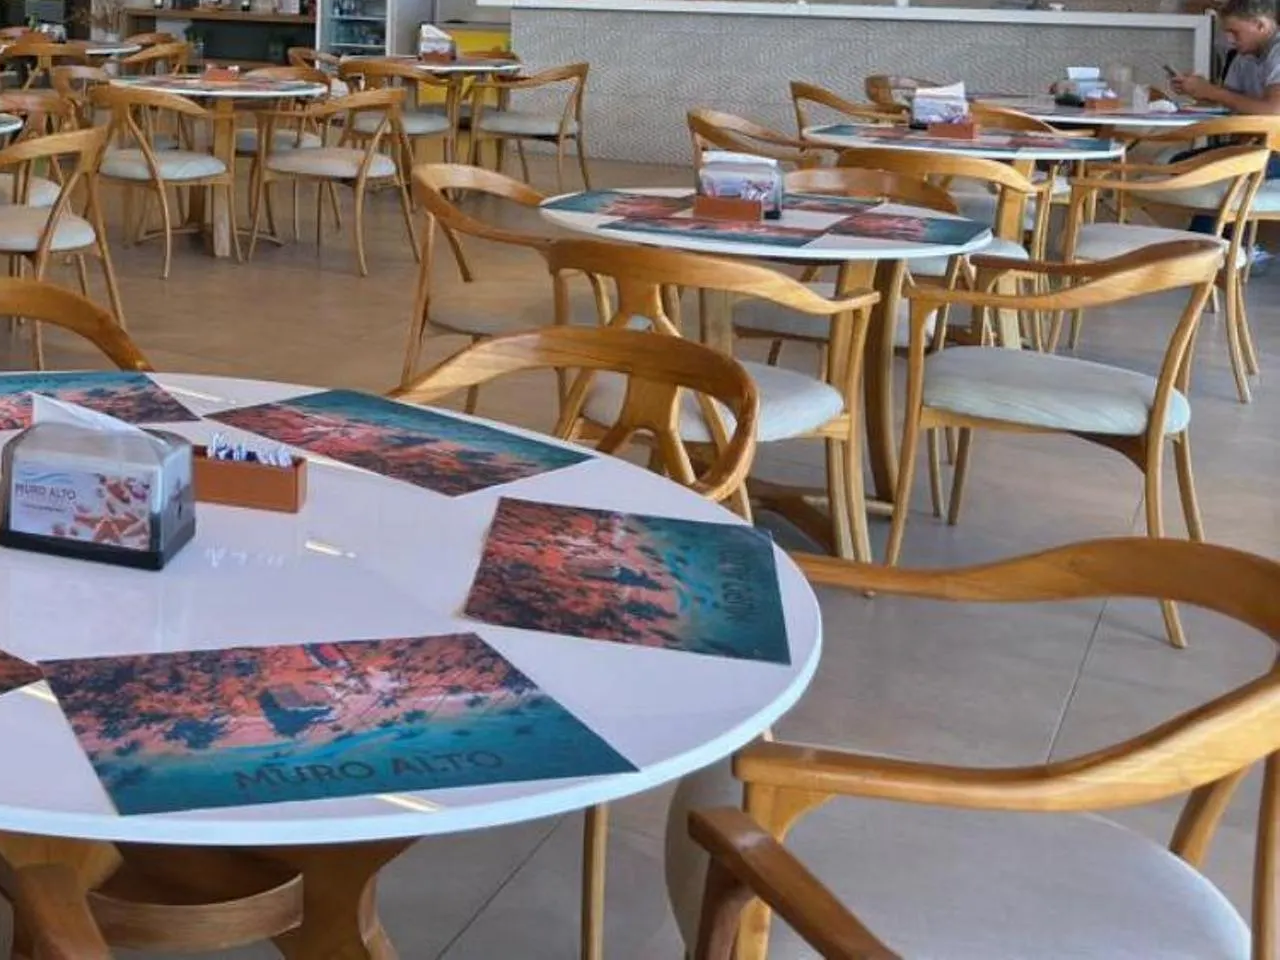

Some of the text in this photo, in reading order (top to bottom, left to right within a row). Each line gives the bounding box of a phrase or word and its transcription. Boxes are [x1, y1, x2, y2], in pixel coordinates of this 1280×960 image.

[49, 486, 77, 500] ALTO
[235, 749, 503, 792] MURO ALTO
